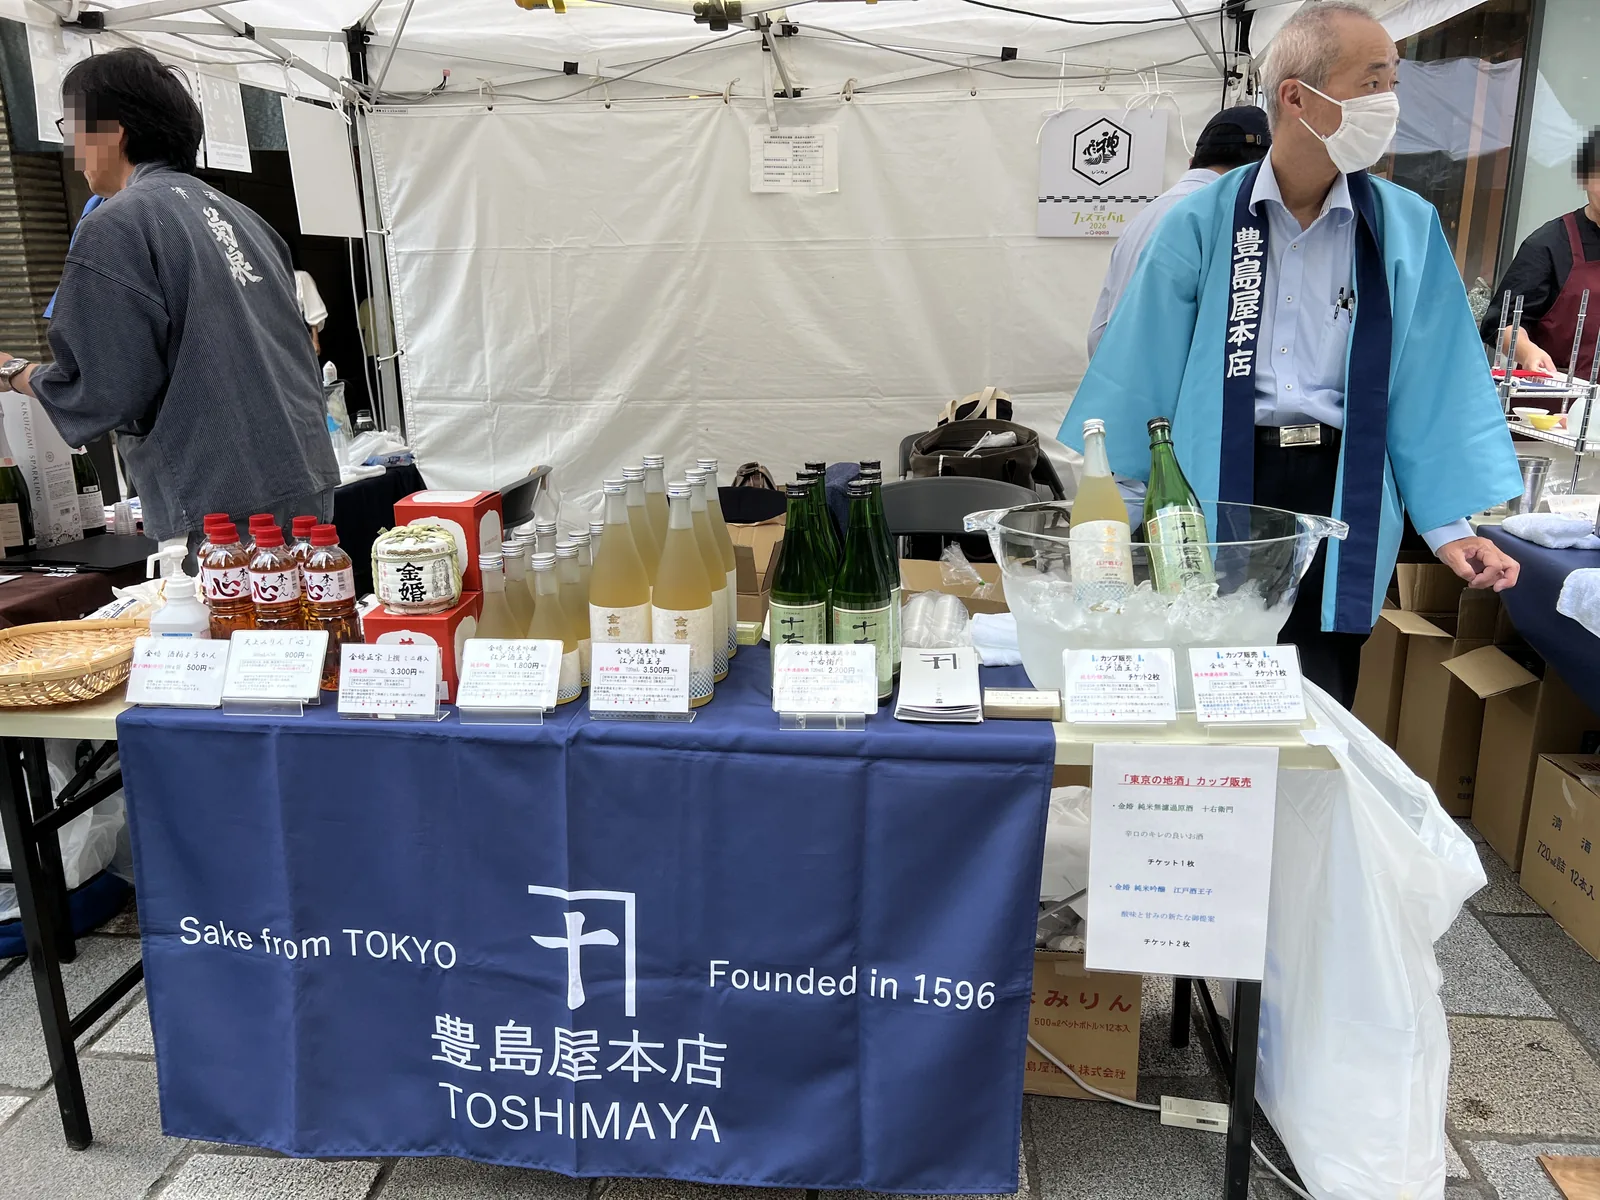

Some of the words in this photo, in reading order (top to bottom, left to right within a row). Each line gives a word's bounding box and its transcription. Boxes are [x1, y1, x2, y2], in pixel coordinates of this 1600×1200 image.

[1072, 211, 1127, 225] フェスティバル
[1226, 227, 1264, 378] 豊島屋本店
[29, 455, 43, 503] SPARKLING
[212, 577, 241, 597] 心
[396, 562, 427, 602] 金婚
[253, 581, 279, 602] 心
[285, 651, 306, 659] 900円
[619, 656, 662, 666] 江戸酒王子
[1101, 654, 1133, 662] カップ販売
[1226, 651, 1259, 659] カップ販売
[186, 663, 208, 672] 500円
[1128, 673, 1161, 682] チケット2枚
[1255, 670, 1287, 679] チケット1枚
[1123, 774, 1252, 788] 「東京の地酒」カップ販売
[1201, 805, 1233, 814] 十右衛門
[1125, 829, 1204, 841] 辛口のキレの良いお酒
[1551, 814, 1593, 855] 清酒
[1147, 858, 1195, 868] チケット1枚
[1173, 886, 1213, 896] 江戸酒王子
[1121, 910, 1216, 923] 酸味と甘みの新たな御提案
[179, 916, 253, 950] Sake
[260, 925, 331, 961] from
[342, 927, 456, 969] TOKYO
[1143, 937, 1191, 948] チケット2枚
[709, 958, 858, 996] Founded
[869, 967, 898, 1000] in
[912, 973, 996, 1010] 1596
[431, 1012, 728, 1089] 豊島屋本店
[438, 1081, 722, 1143] TOSHIMAYA
